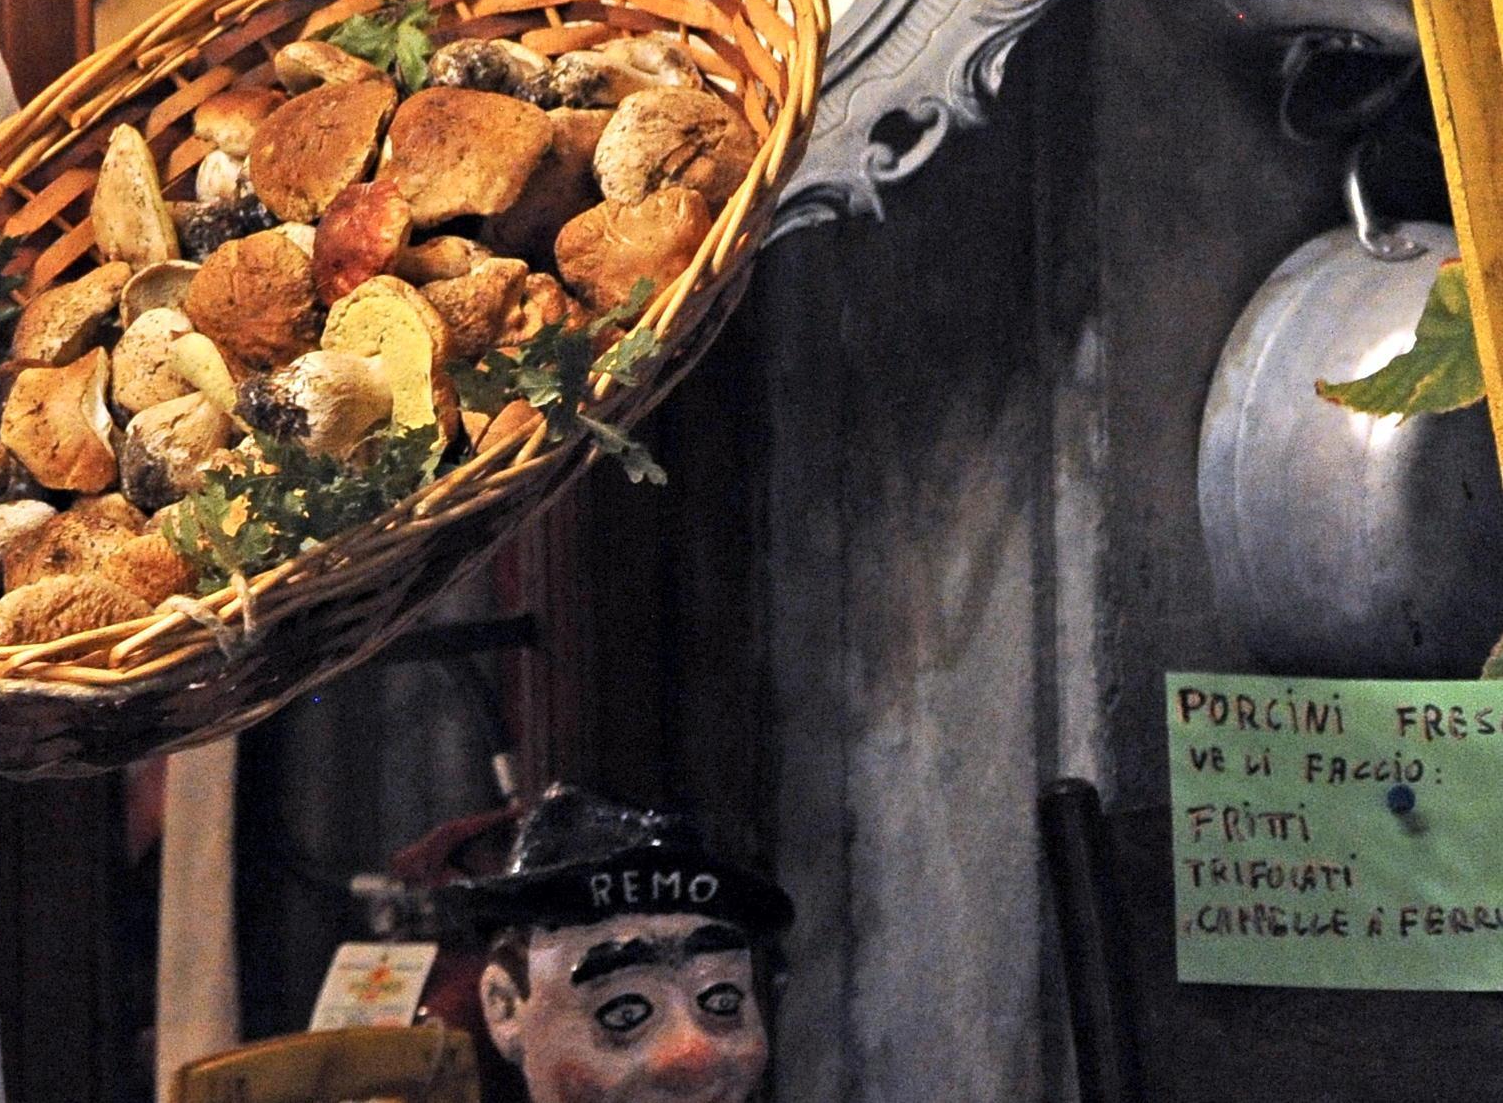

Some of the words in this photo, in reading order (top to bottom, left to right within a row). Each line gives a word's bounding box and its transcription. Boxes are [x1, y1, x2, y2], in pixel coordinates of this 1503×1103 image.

[1177, 687, 1345, 736] PORCINI
[1396, 703, 1503, 742] FRES
[1189, 747, 1226, 774] VE
[589, 870, 719, 907] REMO
